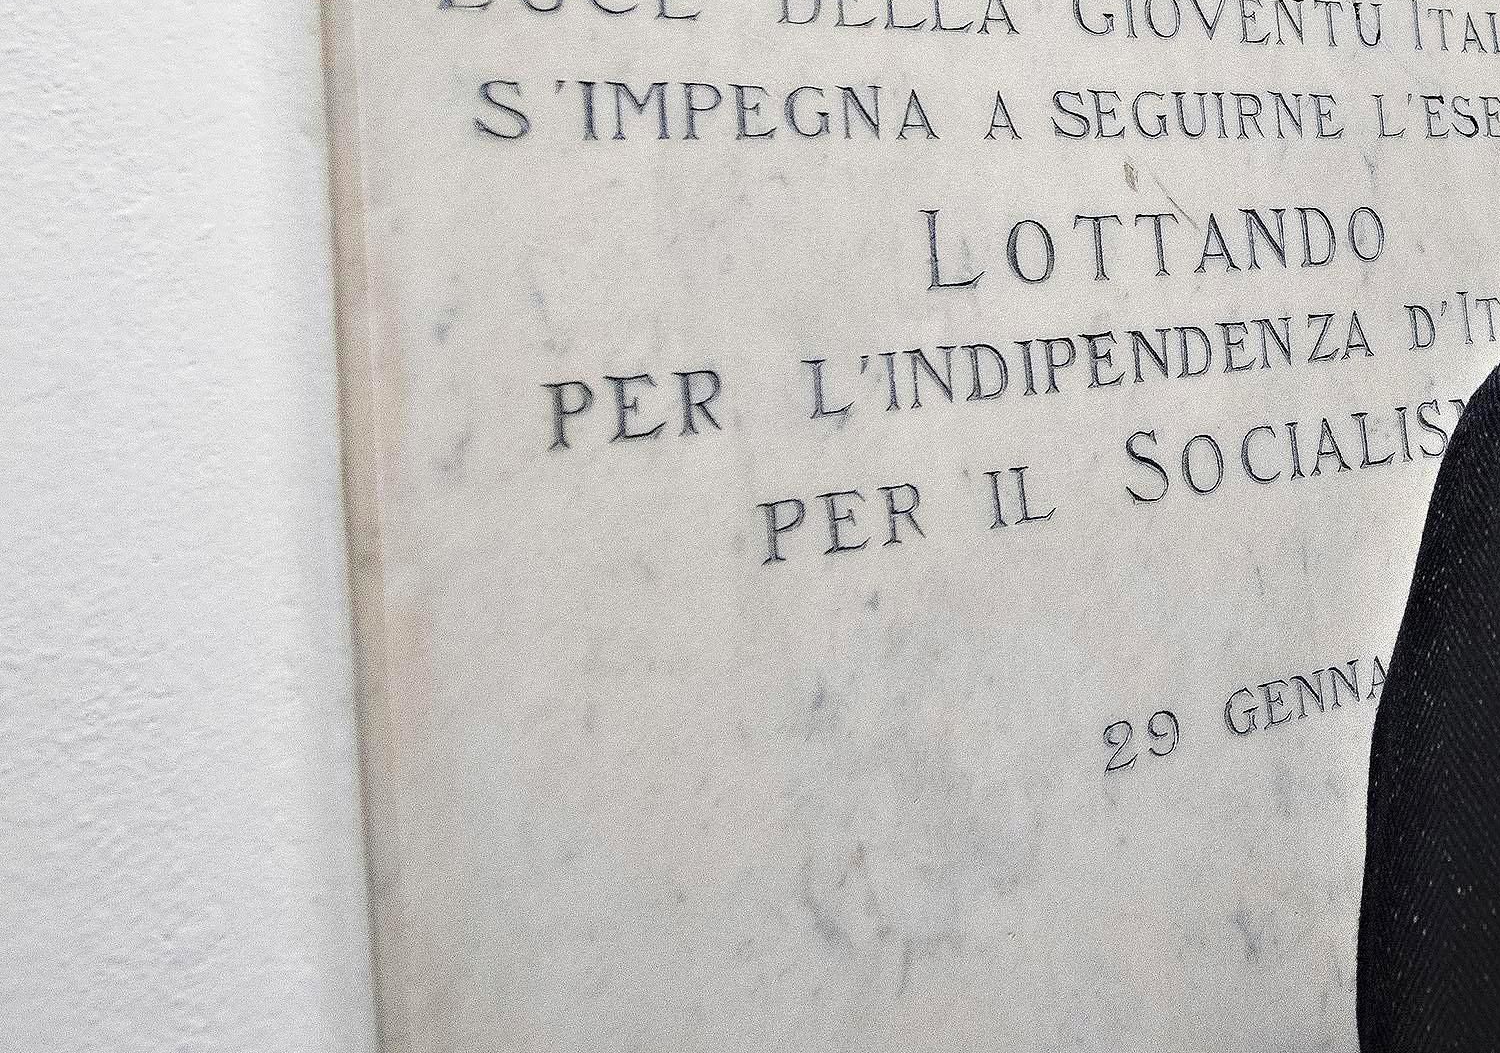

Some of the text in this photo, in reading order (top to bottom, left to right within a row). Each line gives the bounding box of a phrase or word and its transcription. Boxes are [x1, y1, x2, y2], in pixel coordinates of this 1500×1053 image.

[982, 89, 1022, 141] A
[1051, 89, 1344, 141] SEGUIRNE
[918, 205, 1385, 291] LOTTANDO
[540, 368, 723, 451] PER
[800, 310, 1375, 420] L'INDIPENDENZA
[756, 399, 1466, 567] PER IL SOCIALIS
[1103, 655, 1388, 774] 29 GENNA
